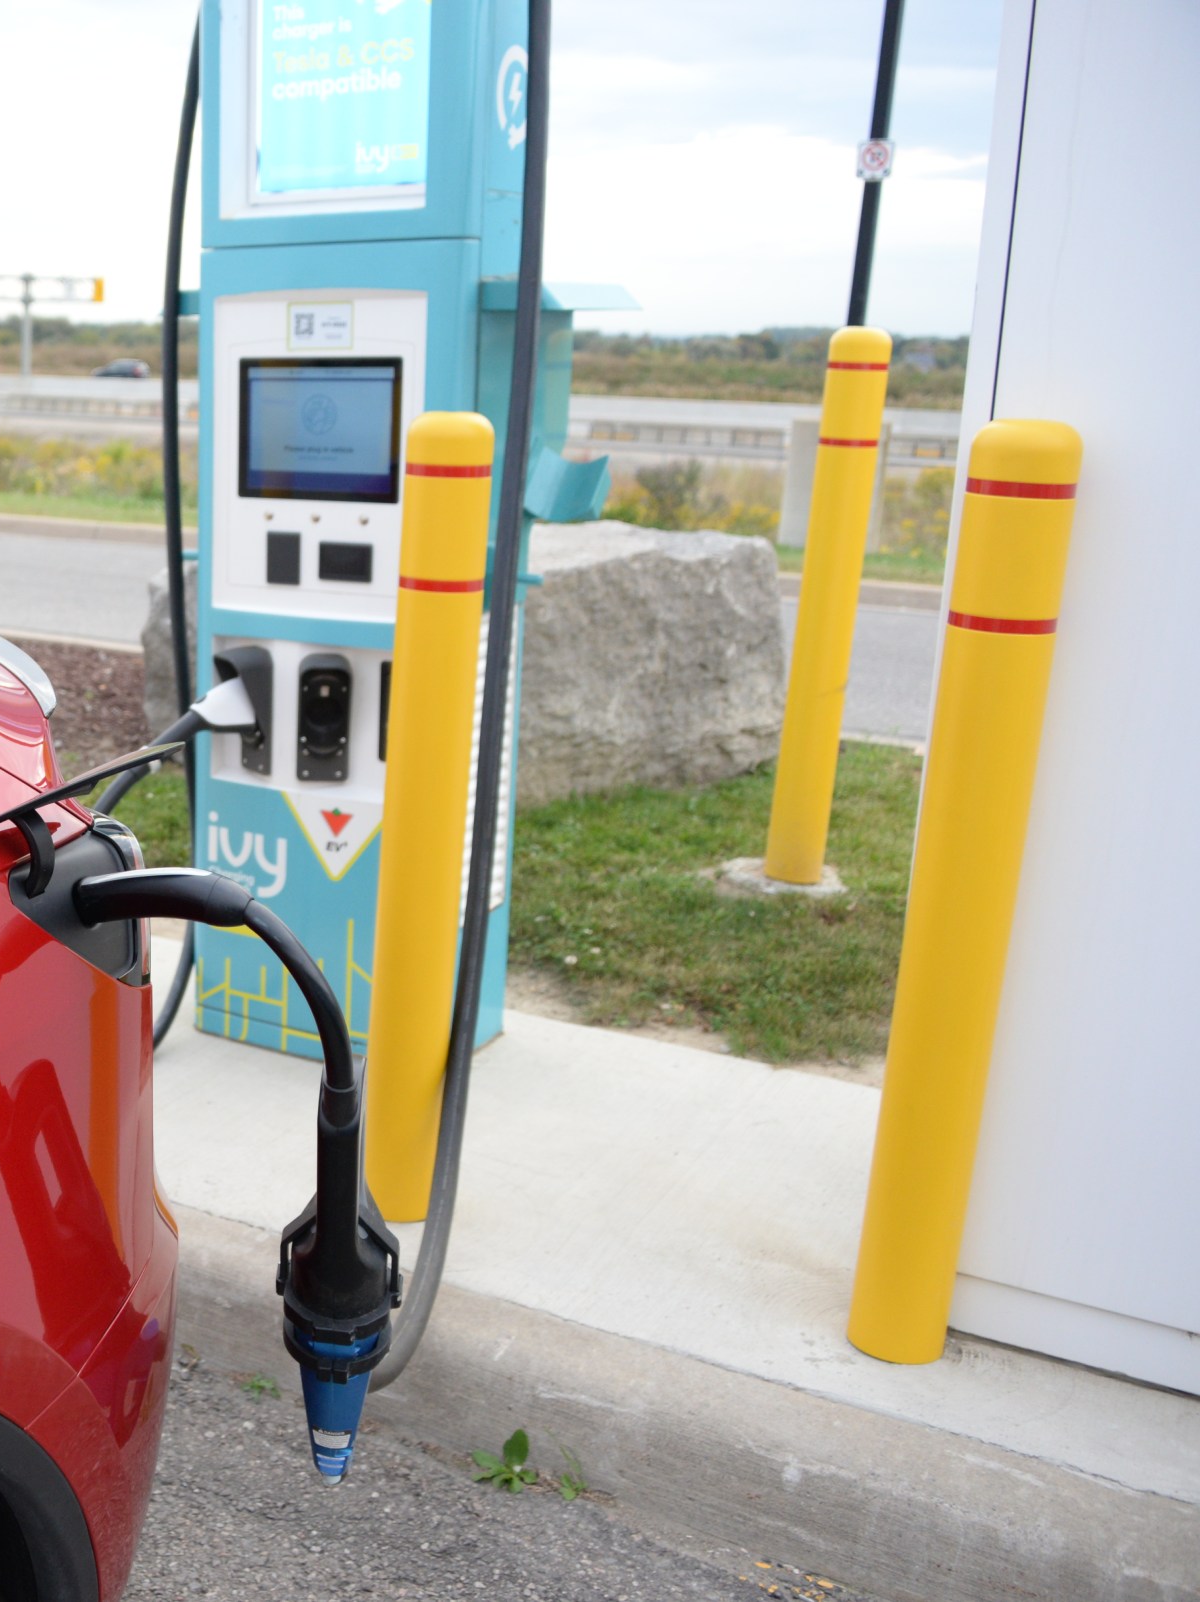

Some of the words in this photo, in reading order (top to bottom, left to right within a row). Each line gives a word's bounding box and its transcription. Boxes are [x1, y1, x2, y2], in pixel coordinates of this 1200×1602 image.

[272, 23, 335, 40] charger
[338, 16, 351, 32] is
[273, 4, 304, 21] This
[273, 47, 330, 73] Tesla
[337, 44, 354, 67] &
[361, 38, 415, 64] CCS
[272, 66, 402, 101] compatible
[355, 140, 390, 173] ivy
[207, 811, 288, 899] ivy
